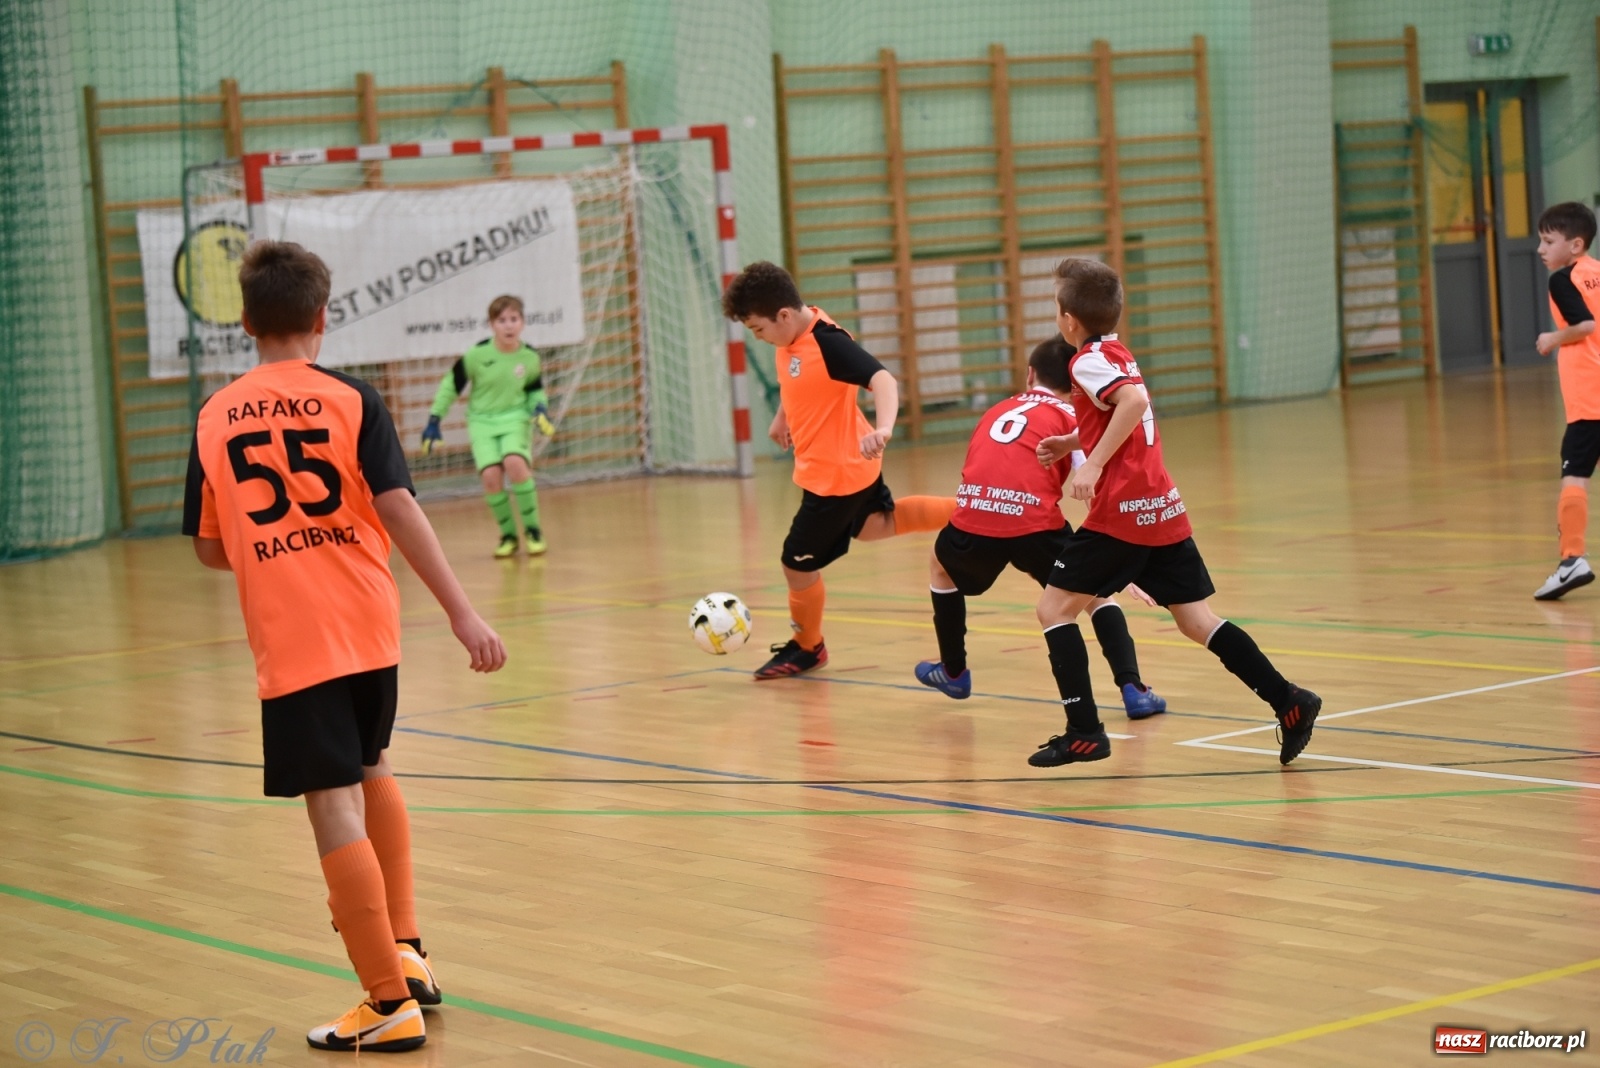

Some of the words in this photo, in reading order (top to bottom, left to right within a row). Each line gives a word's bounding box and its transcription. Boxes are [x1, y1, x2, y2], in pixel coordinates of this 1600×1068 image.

[227, 398, 322, 426] RAFAKO
[989, 401, 1040, 444] 6
[226, 428, 343, 526] 55
[970, 498, 1024, 516] WIELKIEGO
[986, 486, 1041, 506] TWORZYMY
